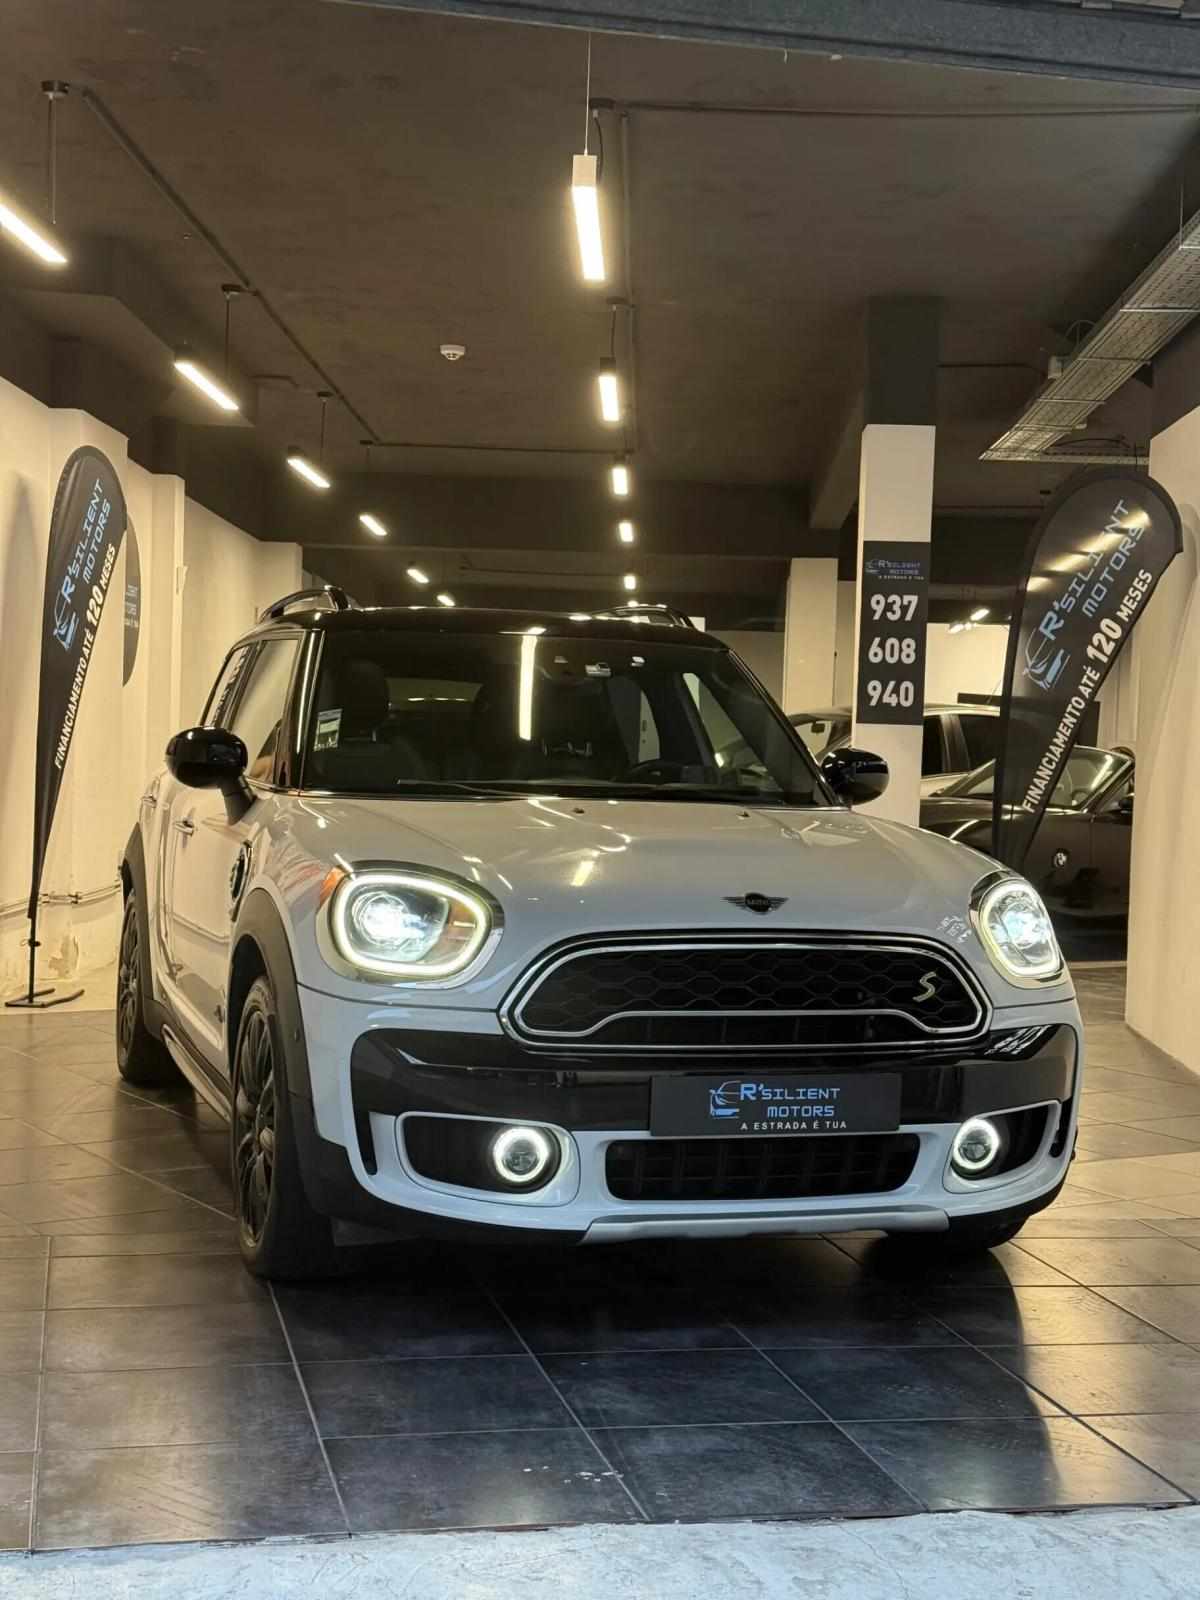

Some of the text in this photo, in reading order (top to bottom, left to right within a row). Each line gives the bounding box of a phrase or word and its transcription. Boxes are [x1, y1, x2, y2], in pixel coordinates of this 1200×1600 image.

[61, 478, 103, 603] R'SILIENT
[82, 498, 111, 584] MOTORS
[1039, 499, 1129, 640] R'SILINT
[1082, 526, 1145, 617] MOTORS
[870, 594, 918, 621] 937
[54, 543, 116, 769] FINANCIAMENTO ATÉ 120 MESES
[868, 637, 916, 664] 608
[867, 680, 914, 707] 940
[1022, 568, 1152, 813] FINANCIAMENTO ATÉ 120 MESES
[740, 1083, 840, 1101] R'SILIENT
[767, 1105, 835, 1118] MOTORS
[740, 1122, 749, 1131] A
[753, 1120, 807, 1131] ESTRADA
[825, 1120, 847, 1129] TUA
